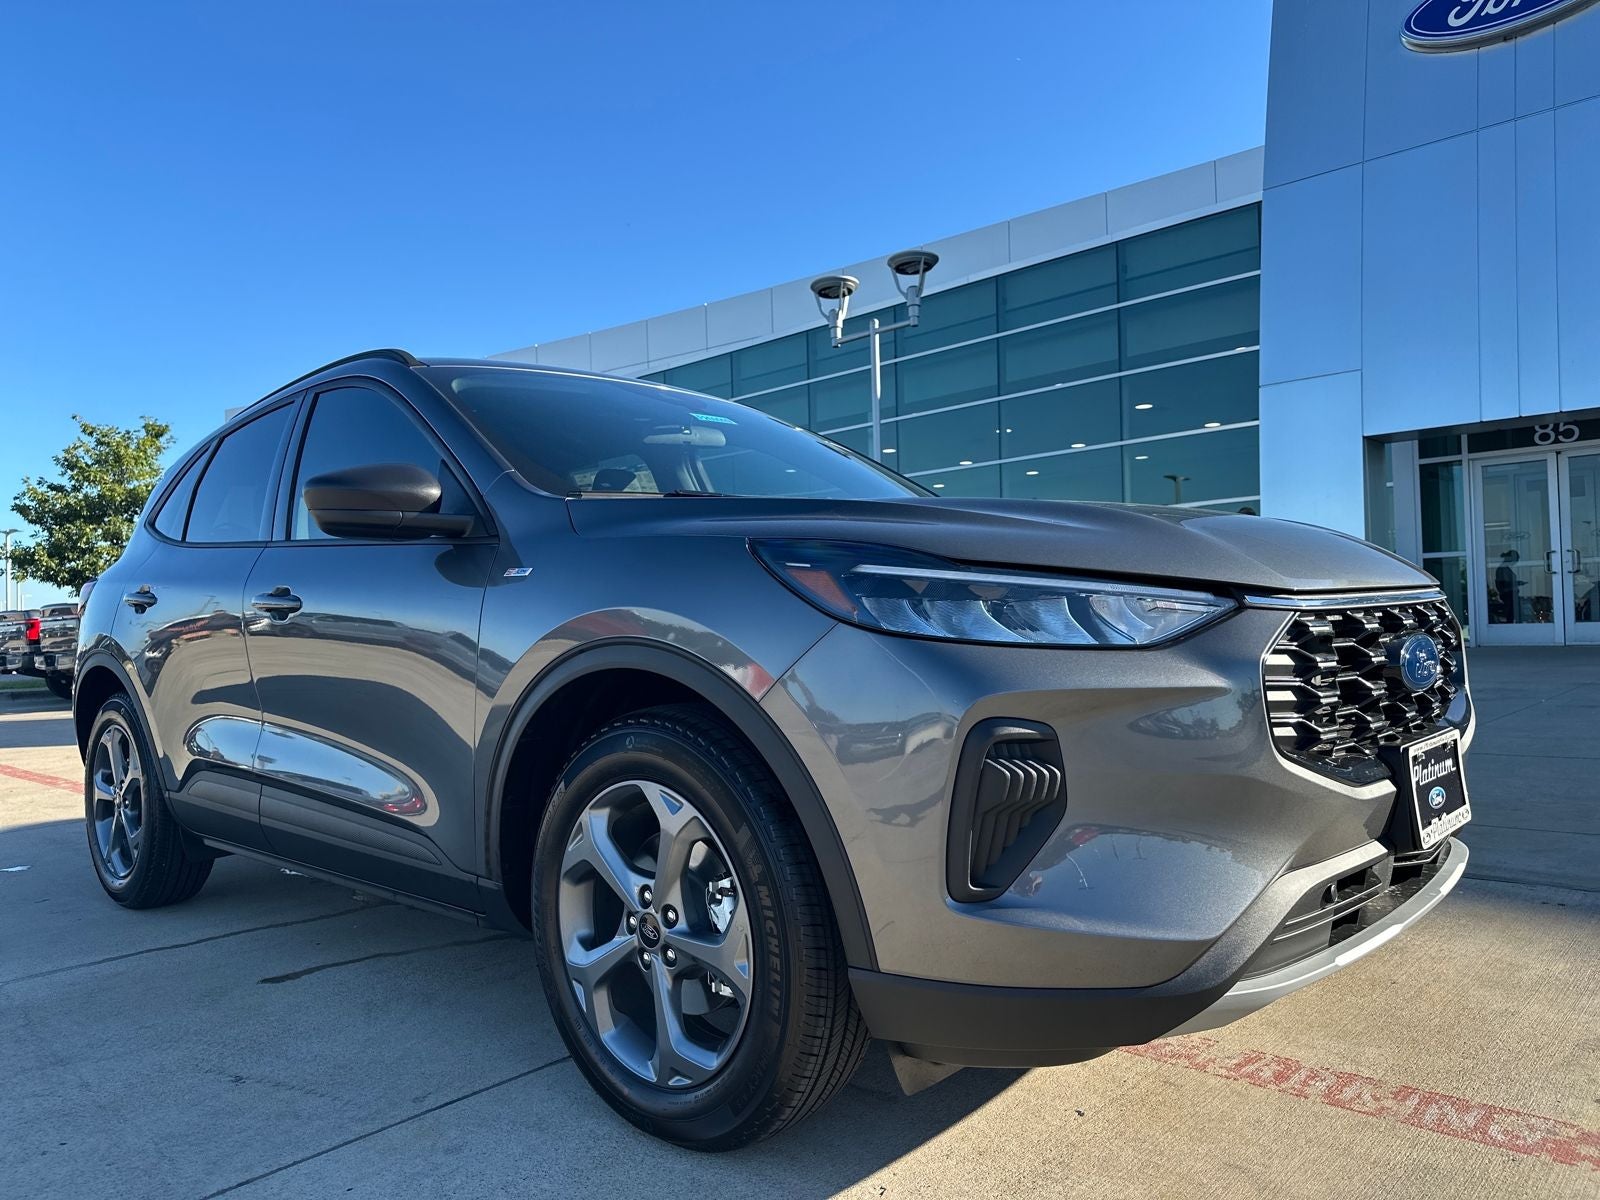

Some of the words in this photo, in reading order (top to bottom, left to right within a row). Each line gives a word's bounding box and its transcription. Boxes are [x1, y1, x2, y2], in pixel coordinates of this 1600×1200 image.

[1533, 422, 1580, 446] 85
[1413, 757, 1457, 786] Platinum
[757, 885, 781, 1018] MICHELIN
